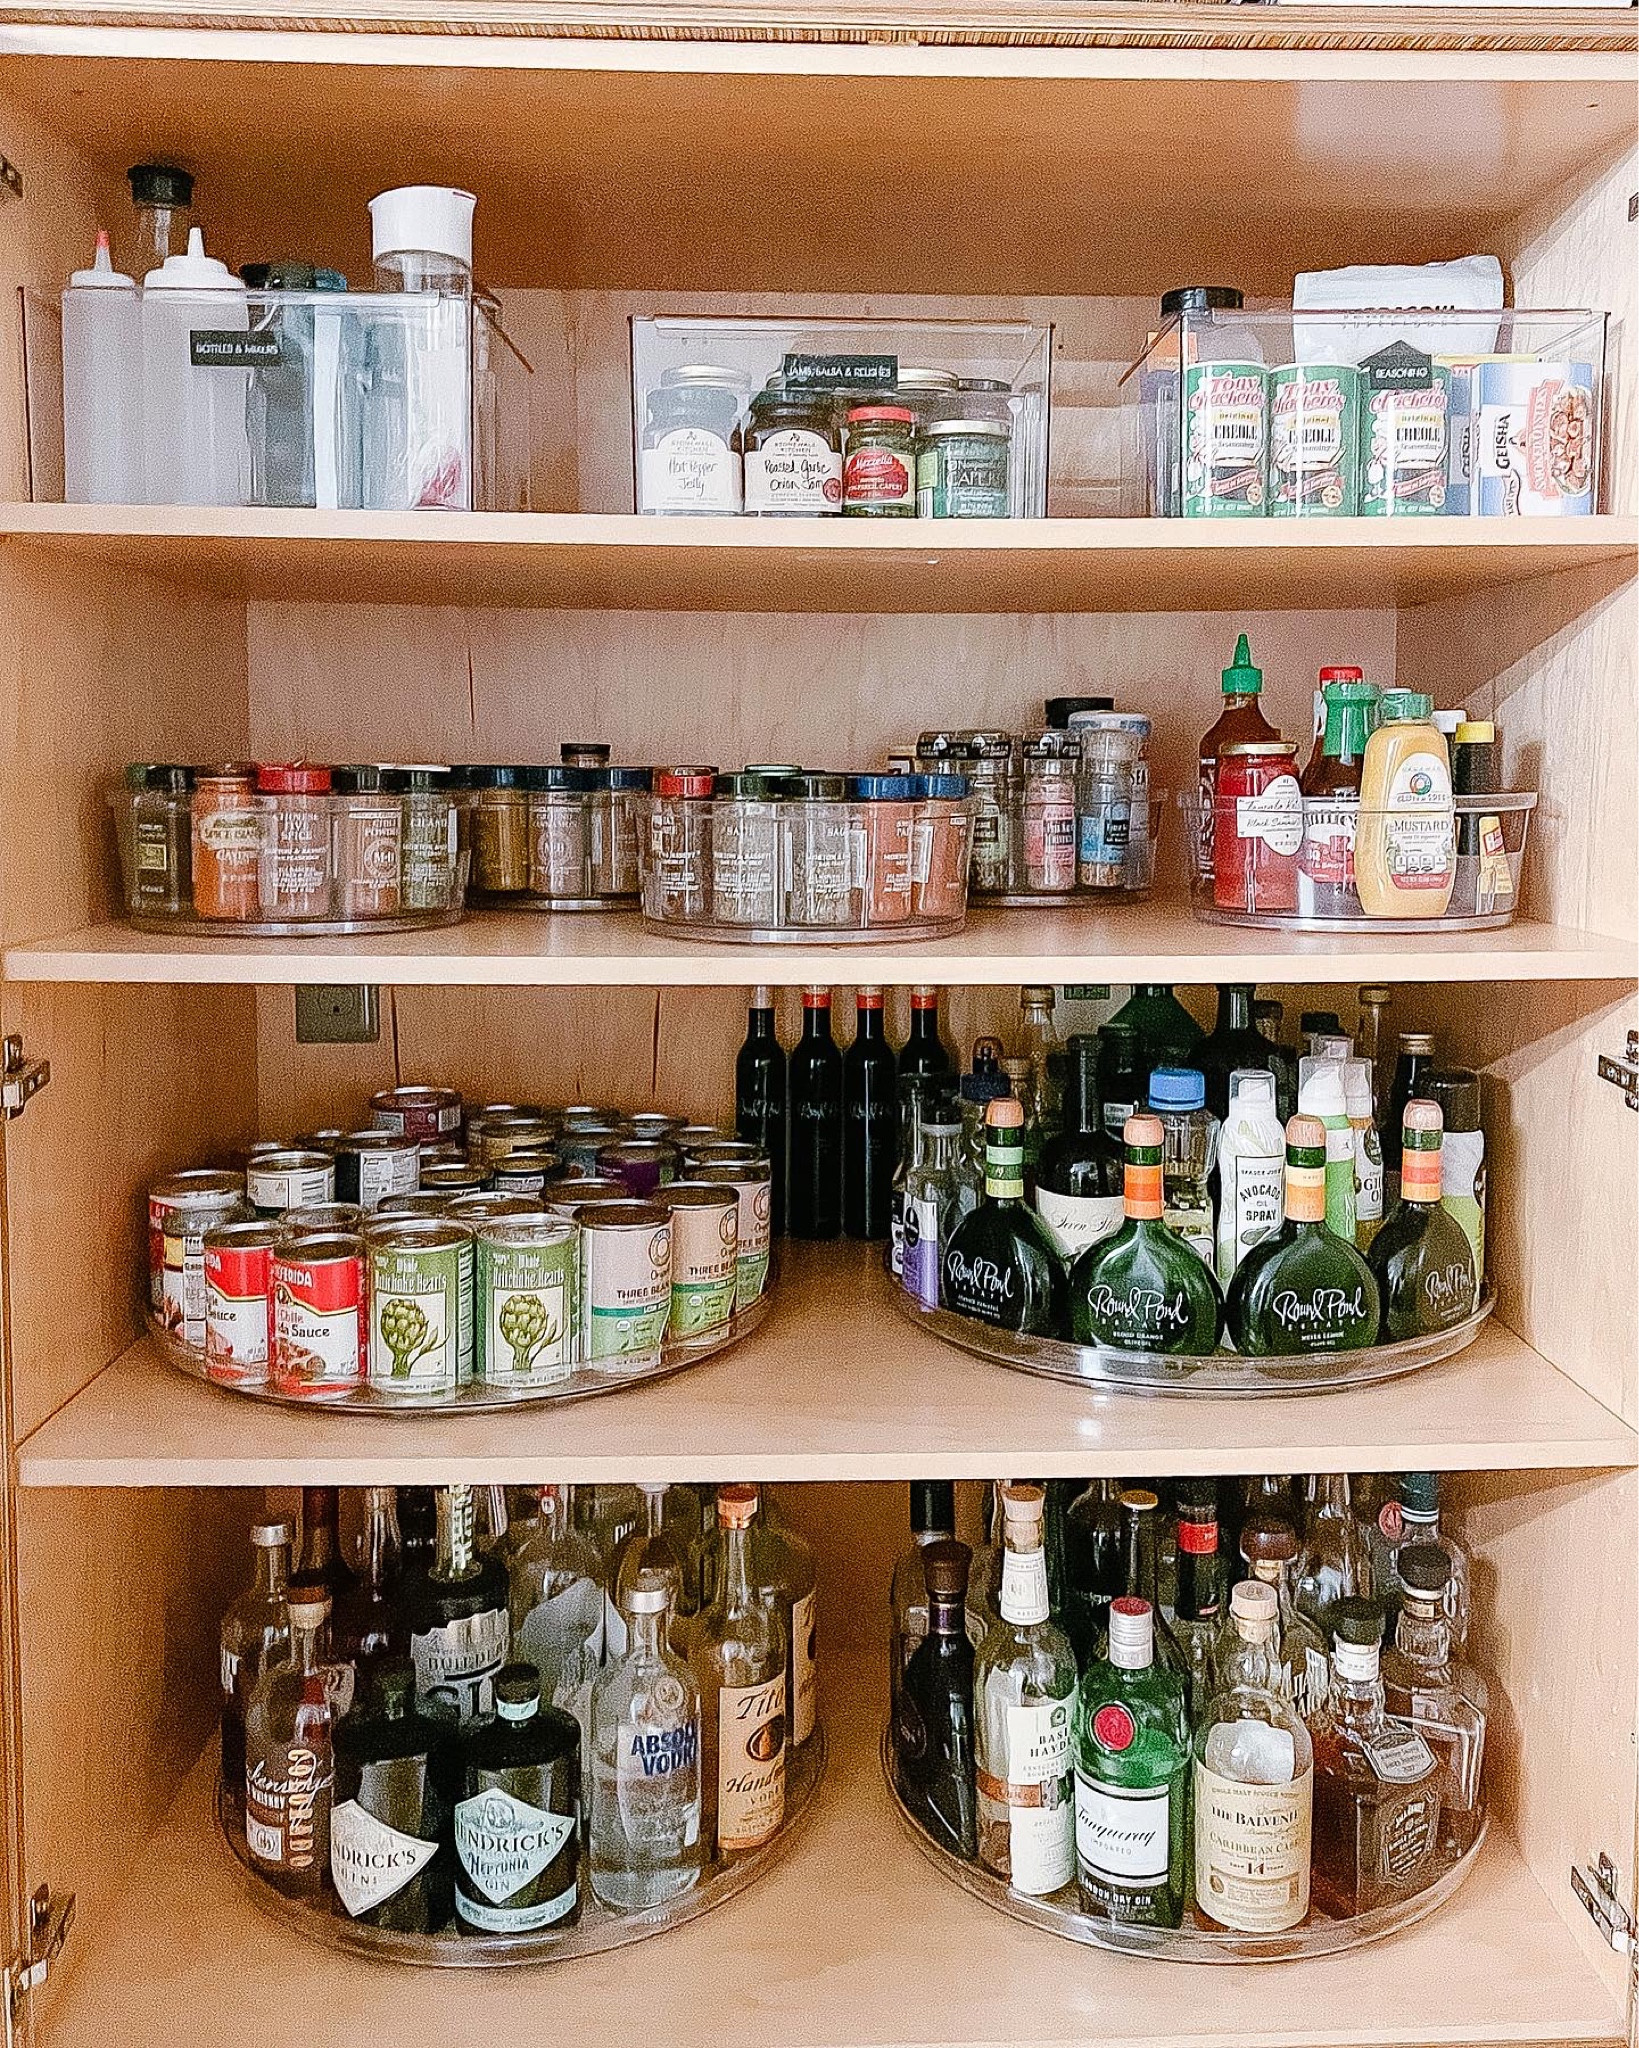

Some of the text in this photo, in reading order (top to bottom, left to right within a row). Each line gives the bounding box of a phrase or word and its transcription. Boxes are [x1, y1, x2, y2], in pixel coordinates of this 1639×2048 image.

[1495, 413, 1511, 470] GEISHA
[1393, 820, 1449, 834] MUSTARD
[1240, 1184, 1281, 1202] AVOCADO
[1053, 1212, 1088, 1232] Seven
[1245, 1210, 1277, 1222] SPRAY
[688, 1266, 721, 1276] THREE
[616, 1289, 649, 1300] THREE
[1087, 1284, 1189, 1325] Round Pond
[1272, 1286, 1367, 1327] Round Pond
[291, 1324, 331, 1338] Sauce
[1039, 1727, 1068, 1746] BASI
[1210, 1805, 1232, 1821] THE
[1078, 1806, 1157, 1847] Tanqueray
[1247, 1861, 1265, 1875] 14
[1112, 1892, 1133, 1906] DRY
[1133, 1895, 1152, 1907] GIN
